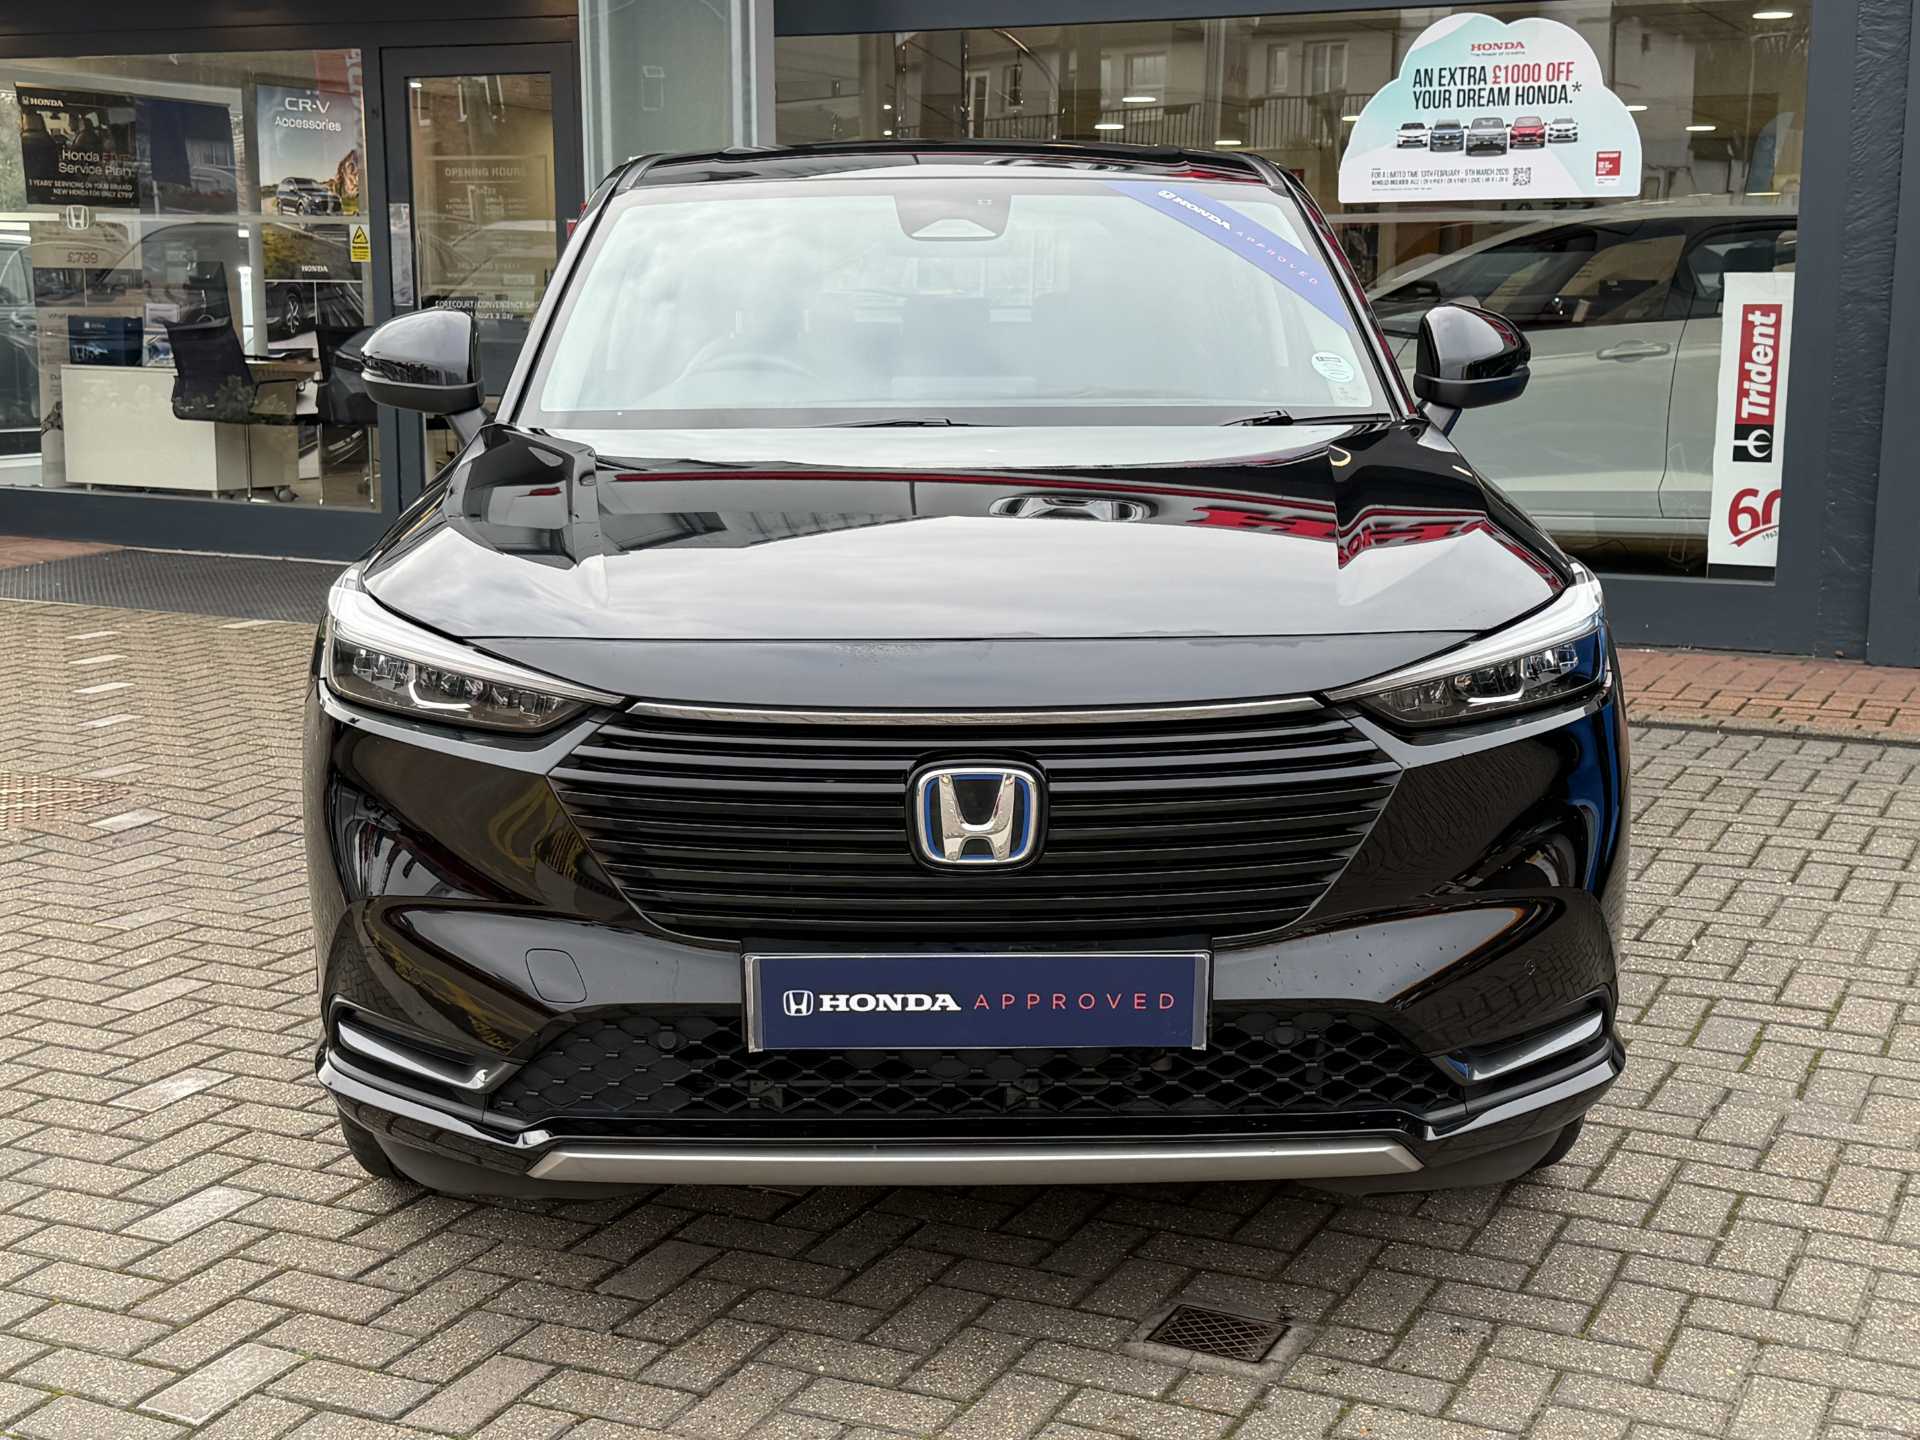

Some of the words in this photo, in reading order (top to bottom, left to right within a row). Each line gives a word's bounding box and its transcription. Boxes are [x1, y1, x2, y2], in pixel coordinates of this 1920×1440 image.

[1471, 41, 1525, 51] HONDA
[1412, 67, 1437, 88] AN
[1438, 65, 1487, 87] EXTRA
[1492, 63, 1541, 84] £1000
[1546, 61, 1575, 82] OFF
[30, 98, 64, 107] HONDA
[1413, 89, 1453, 110] YOUR
[1456, 87, 1511, 108] DREAM
[275, 116, 342, 132] Accessories
[62, 150, 100, 161] Honda
[58, 162, 102, 175] Service
[445, 167, 489, 177] OPENING
[1173, 197, 1232, 231] HONDA
[1236, 231, 1319, 285] APPROVED
[301, 264, 329, 273] HONDA
[1740, 310, 1777, 419] Trident
[819, 993, 962, 1012] HONDA
[973, 992, 1176, 1010] APPROVED
